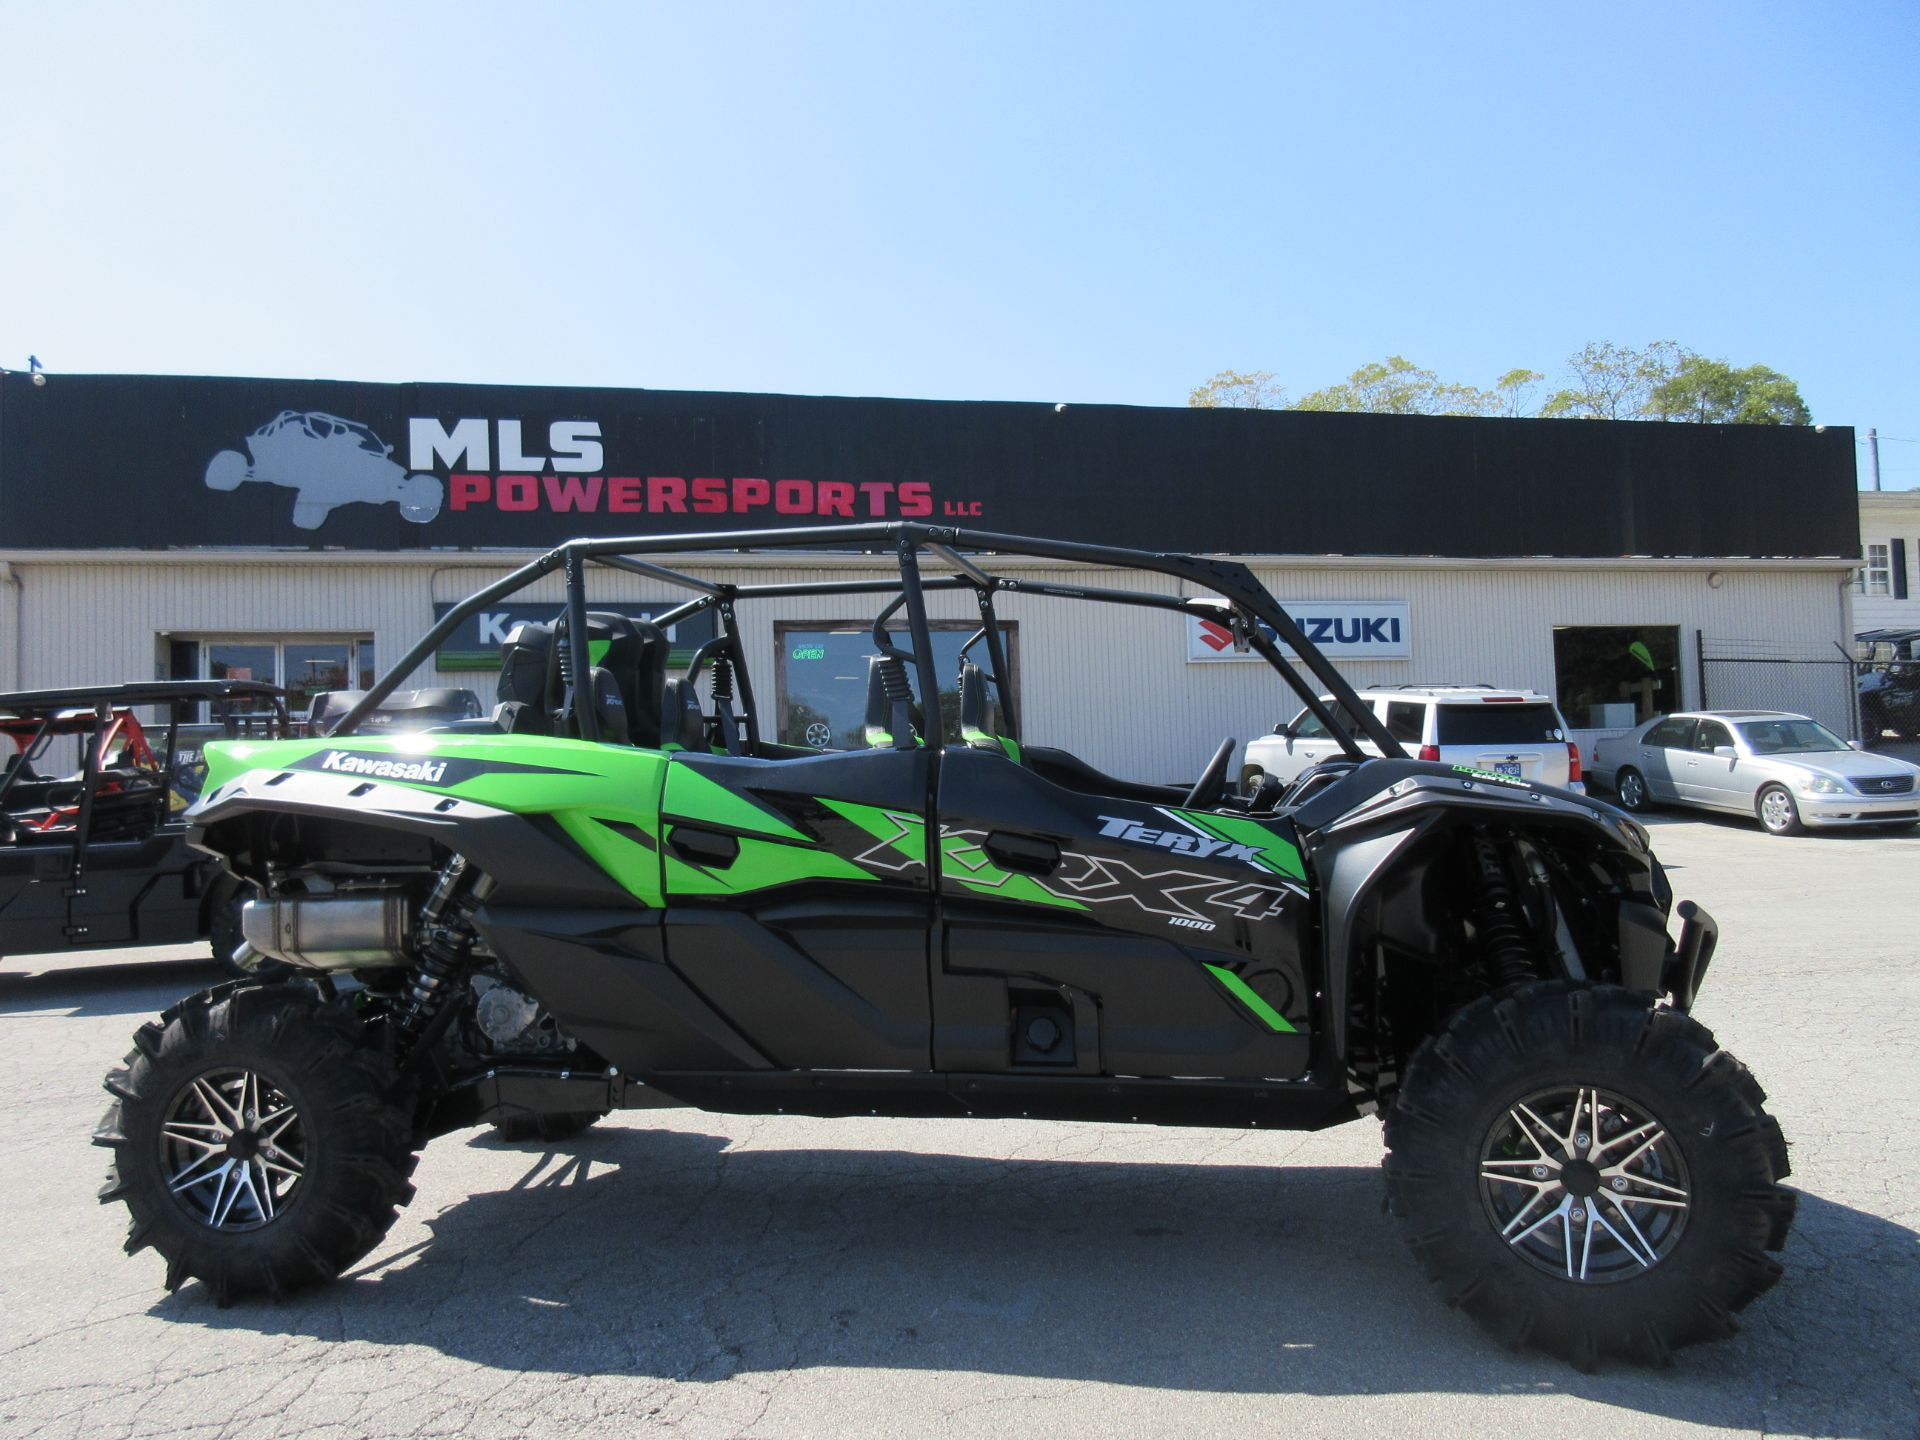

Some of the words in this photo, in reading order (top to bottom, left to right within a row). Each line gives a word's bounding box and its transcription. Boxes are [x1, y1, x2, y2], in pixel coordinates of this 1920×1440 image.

[409, 418, 604, 472] MLS
[450, 475, 934, 518] POWERSPORTS
[944, 500, 983, 517] LLC
[792, 648, 825, 660] OPEN
[321, 750, 448, 783] Kawasaki
[1097, 815, 1268, 862] TERYX
[1168, 916, 1216, 931] 1000
